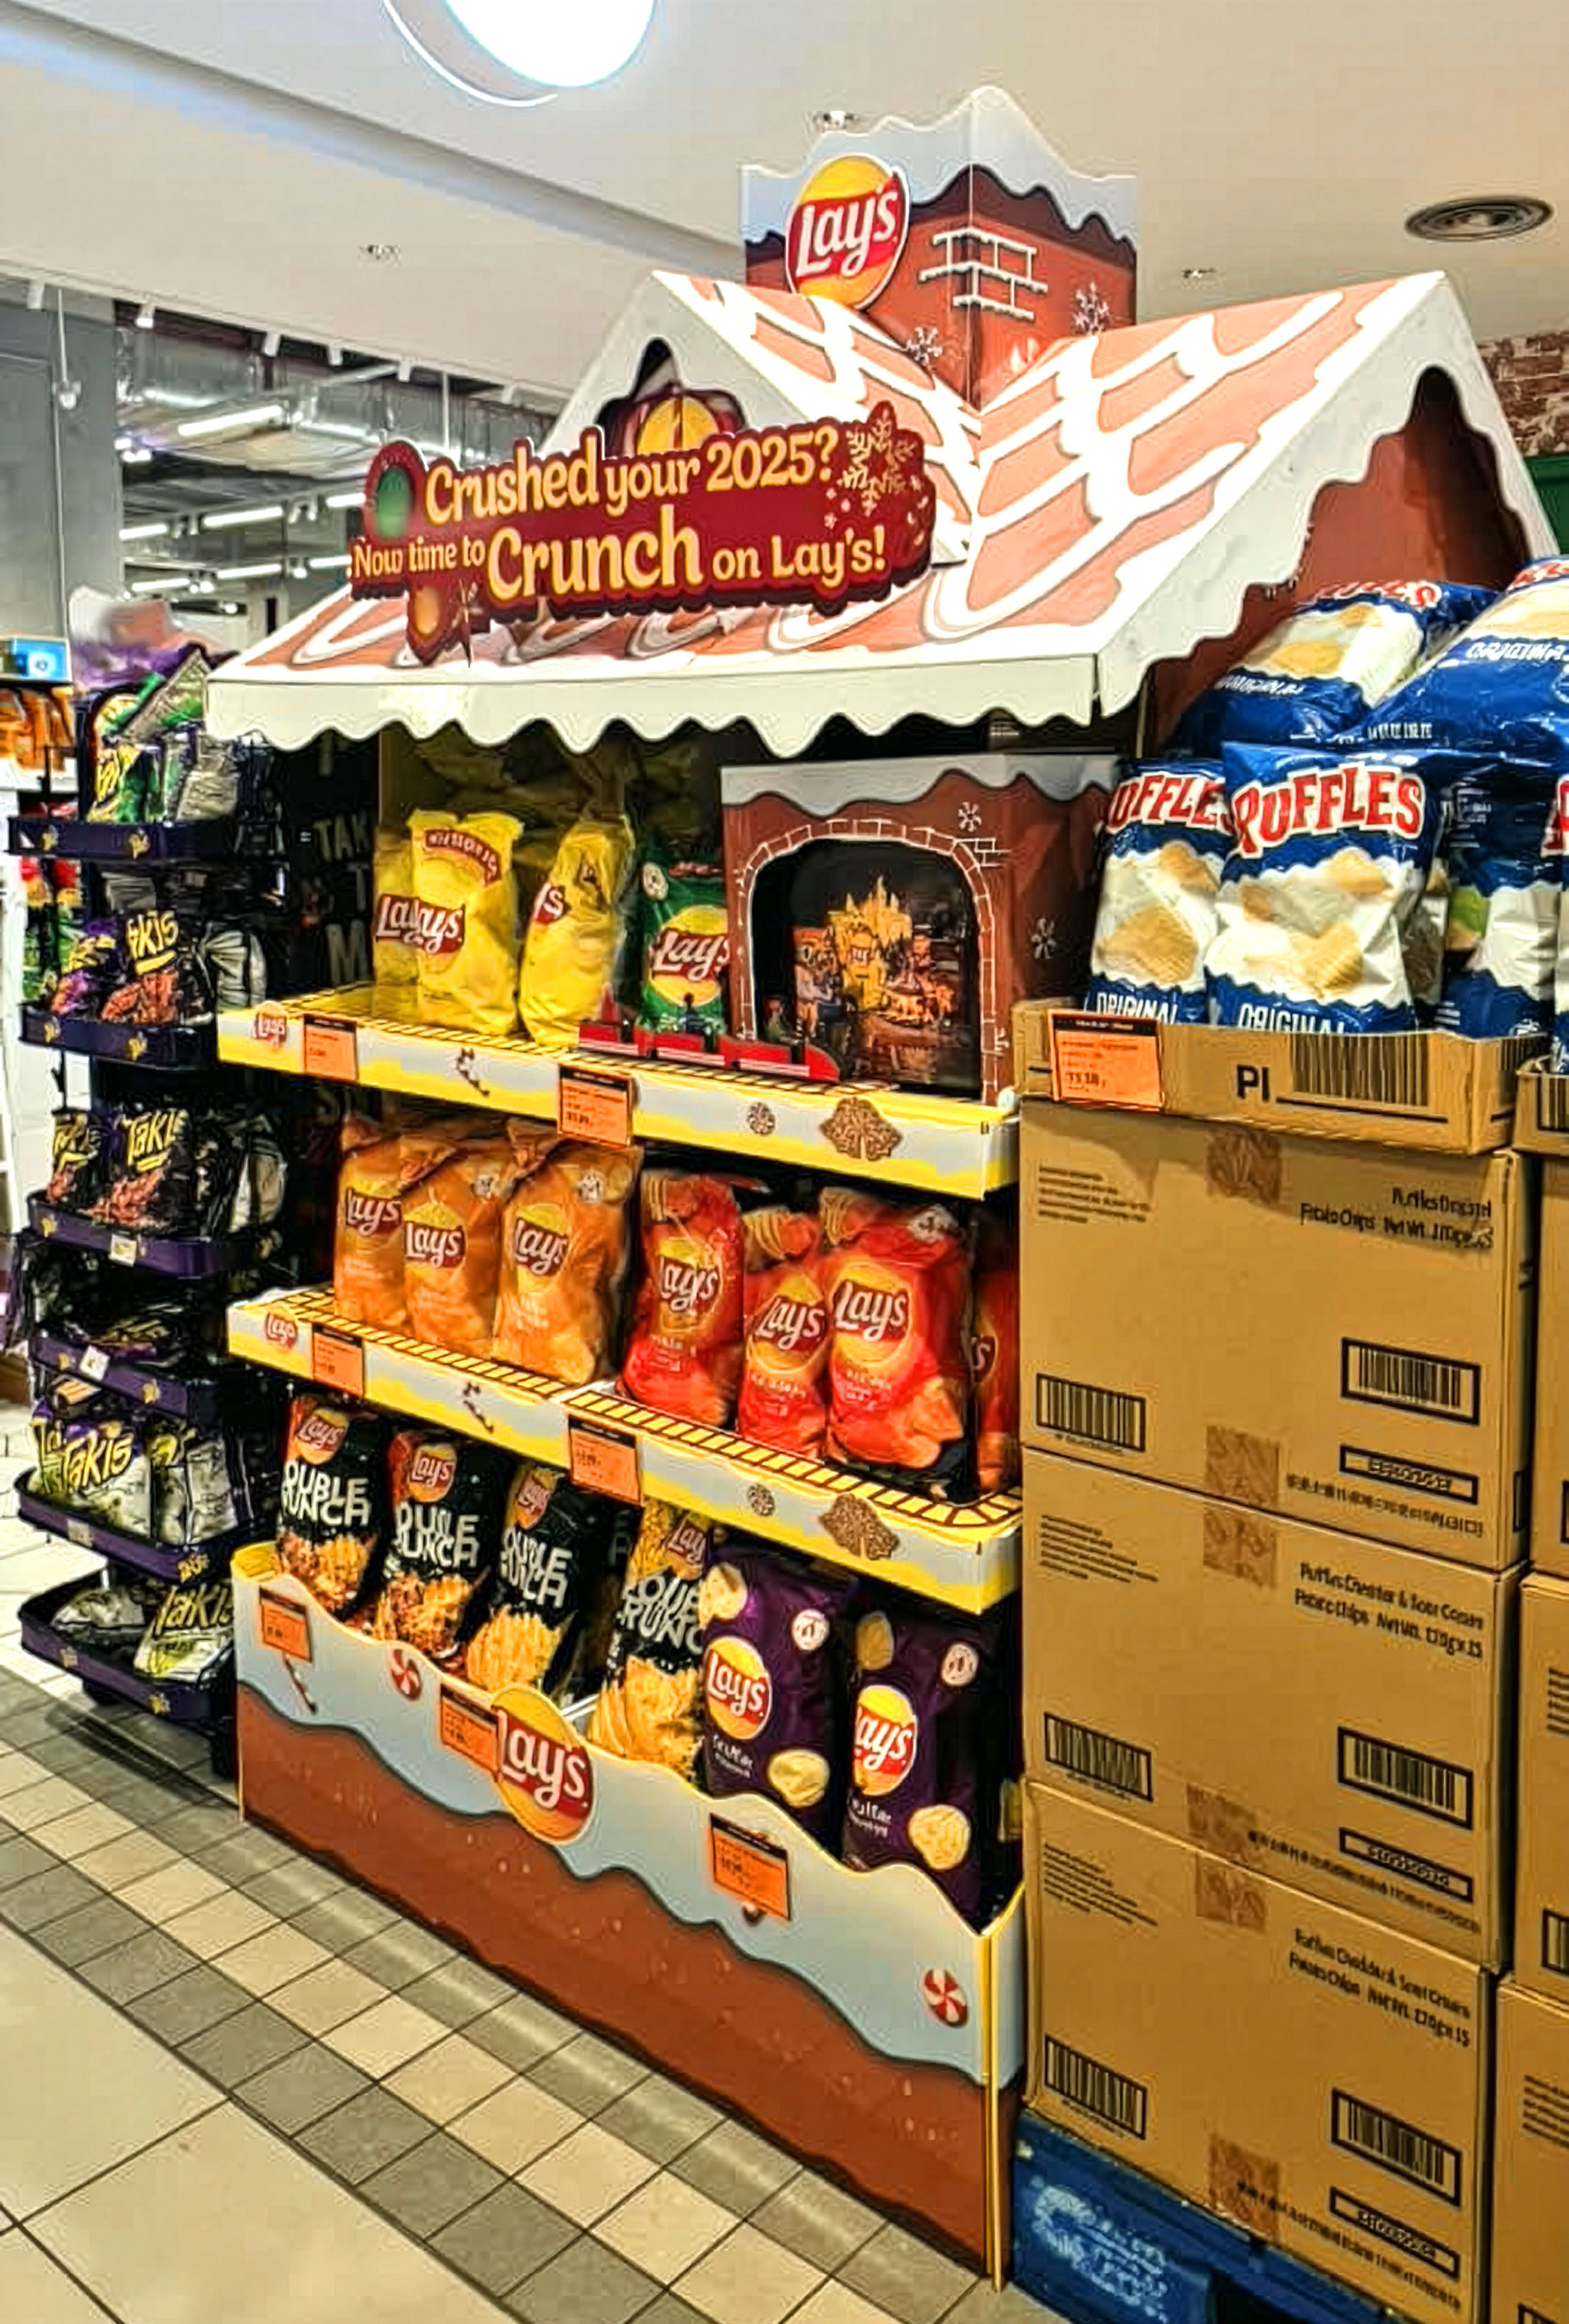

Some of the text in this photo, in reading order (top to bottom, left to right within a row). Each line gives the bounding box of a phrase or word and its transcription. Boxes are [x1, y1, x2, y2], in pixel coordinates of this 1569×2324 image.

[424, 426, 839, 524] Crushed your 2025?
[352, 505, 886, 600] Now time to Crunch on Lay's!
[1107, 774, 1232, 834] UFFLE
[1232, 766, 1424, 856] RUFFLES
